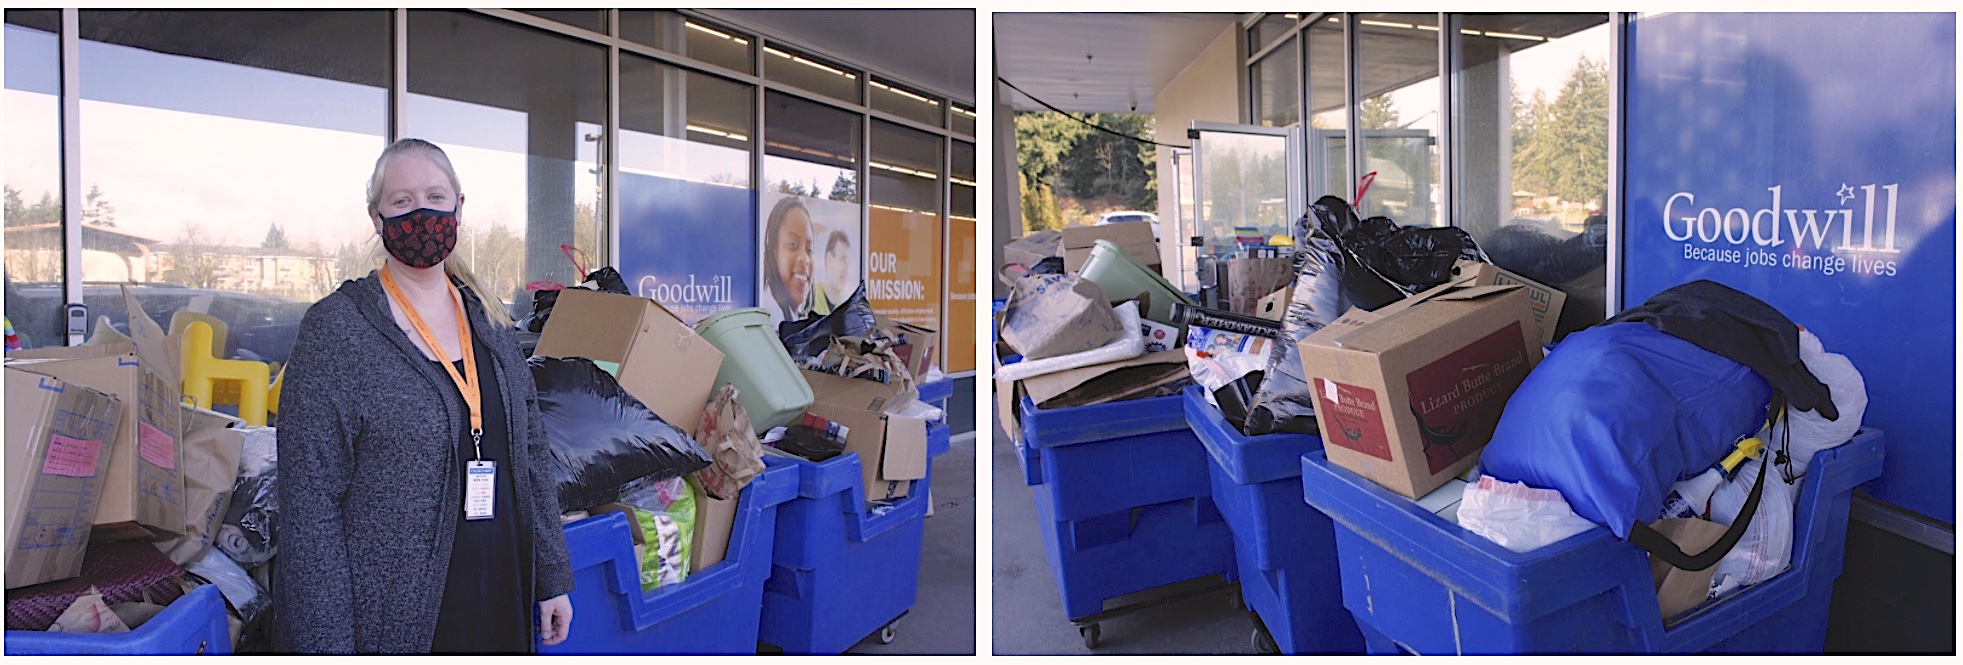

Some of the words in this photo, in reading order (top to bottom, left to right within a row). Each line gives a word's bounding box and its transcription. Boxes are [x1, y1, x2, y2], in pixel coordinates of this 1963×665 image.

[1663, 182, 1900, 253] Goodwill
[869, 251, 897, 273] OUR
[1684, 243, 1741, 263] Because
[1744, 247, 1778, 268] jobs
[1782, 250, 1845, 276] change
[1852, 255, 1897, 277] lives
[638, 273, 733, 304] Goodwill
[869, 279, 925, 300] MISSION:
[680, 304, 694, 313] jobs
[695, 304, 717, 313] change
[718, 304, 731, 312] lives
[1420, 386, 1461, 415] Lizard
[1462, 371, 1492, 394] Butte
[1492, 352, 1524, 377] Brand
[1333, 403, 1365, 418] PRODUCE
[1356, 397, 1377, 411] Brand
[1452, 380, 1504, 415] PRODUCE
